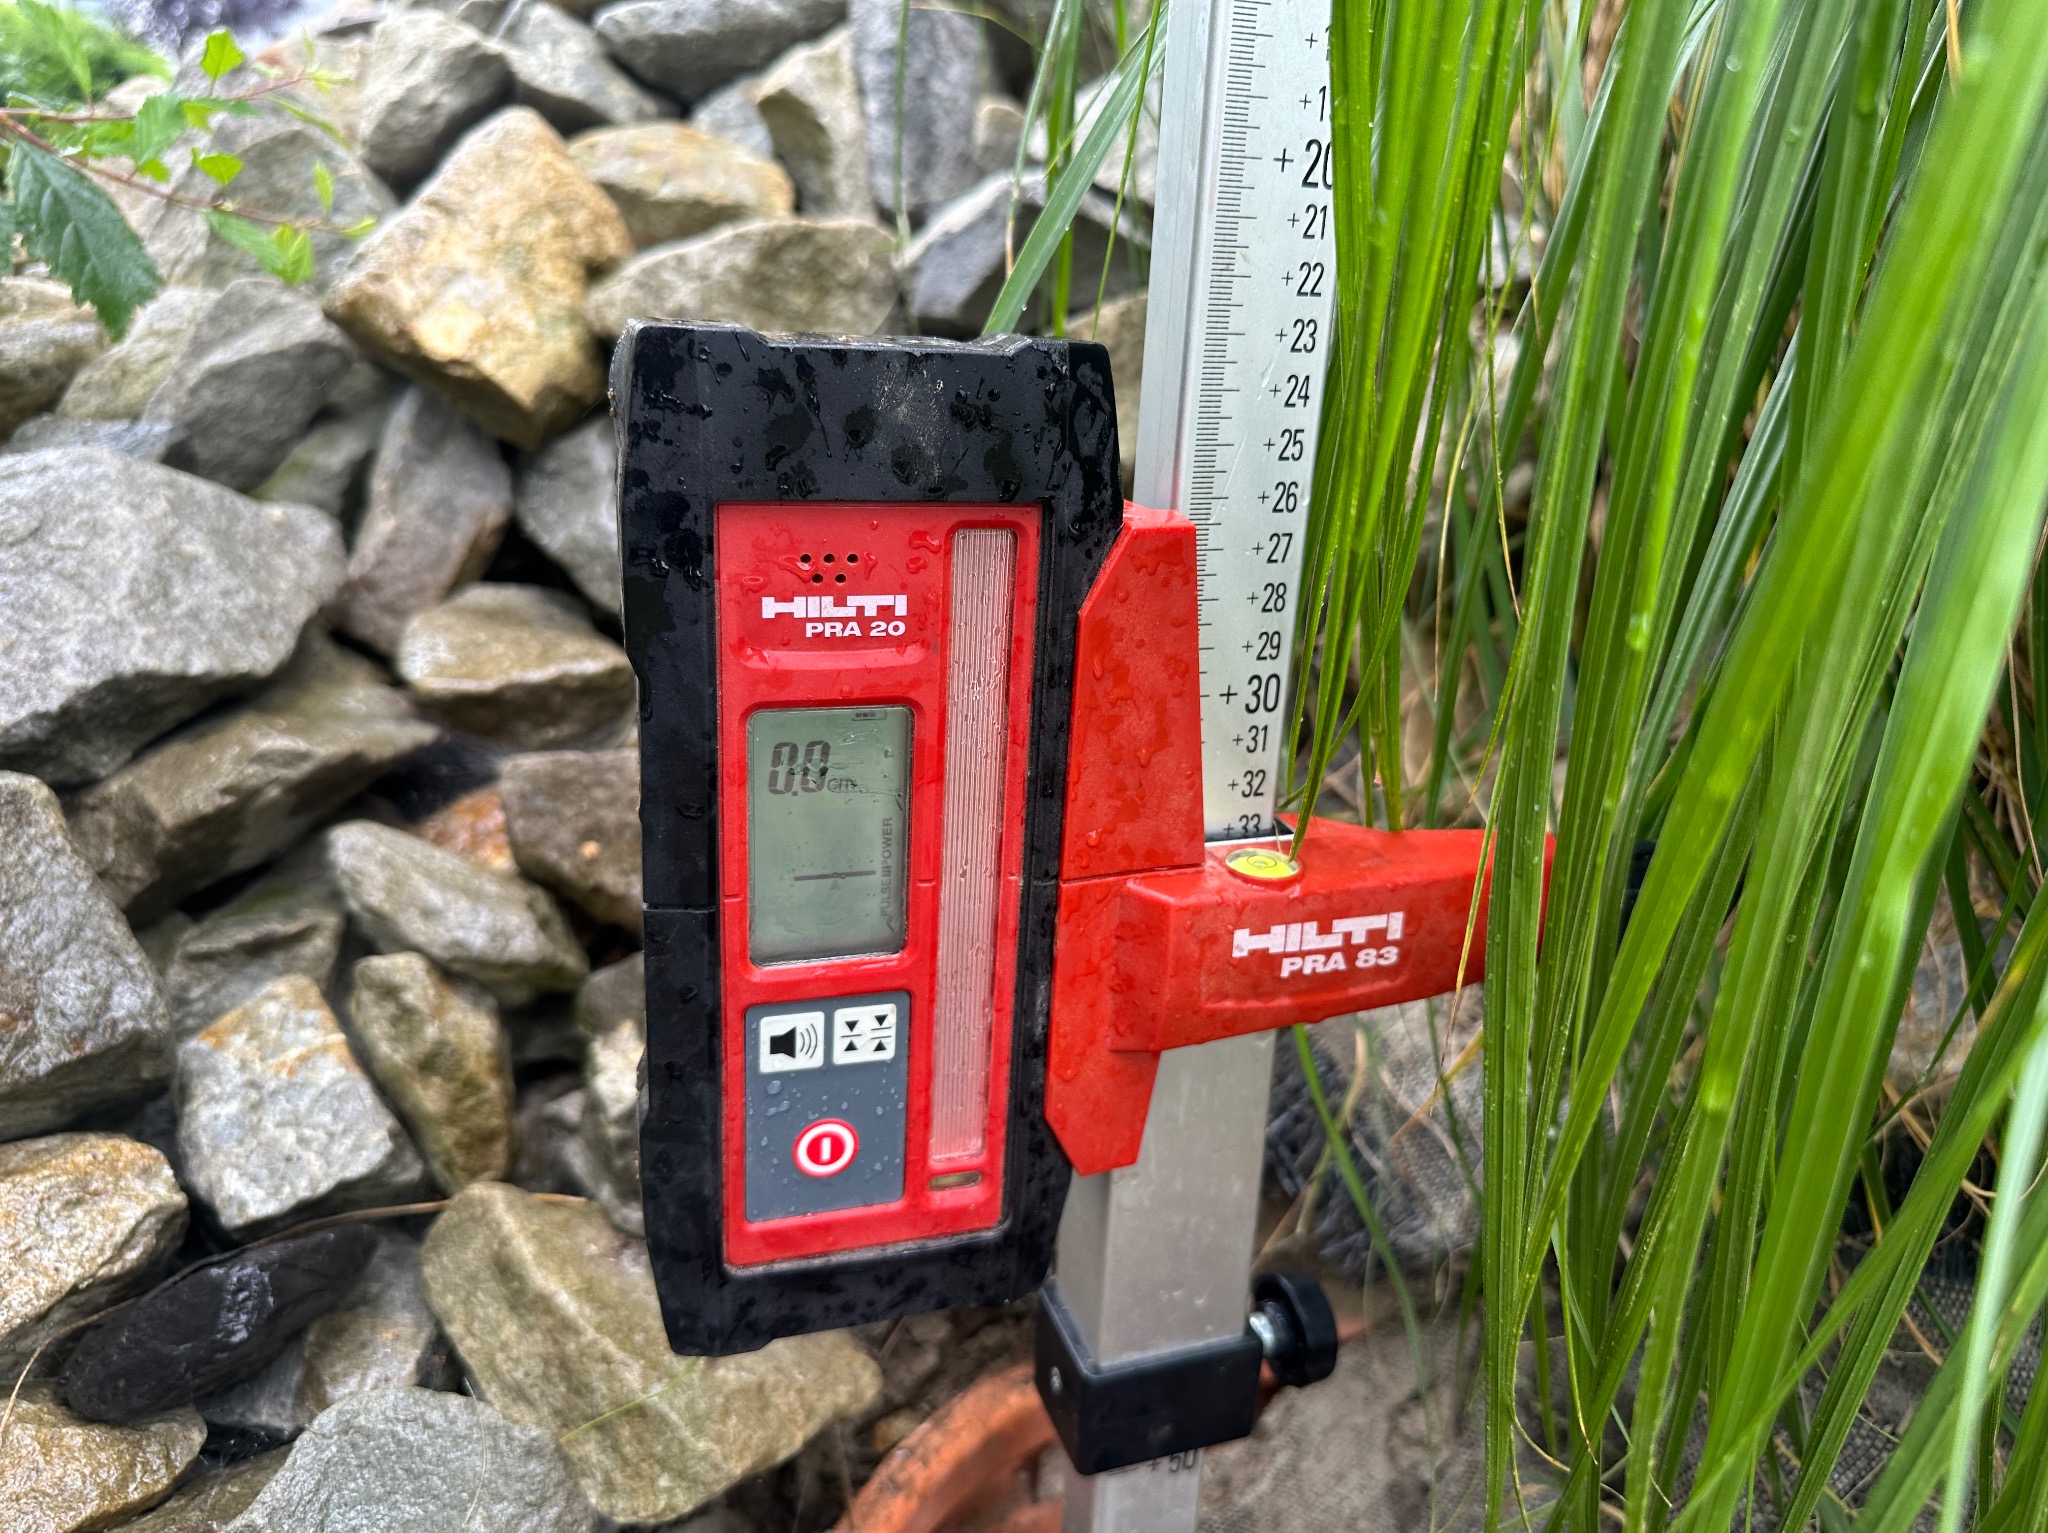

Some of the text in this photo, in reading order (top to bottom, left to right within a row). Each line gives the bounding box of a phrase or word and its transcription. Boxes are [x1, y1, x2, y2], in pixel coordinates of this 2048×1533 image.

[762, 594, 908, 619] HILTI
[805, 620, 907, 638] PRA 20
[768, 740, 831, 795] 0.0
[1232, 911, 1405, 958] HILTI
[1280, 945, 1399, 978] PRA 83
